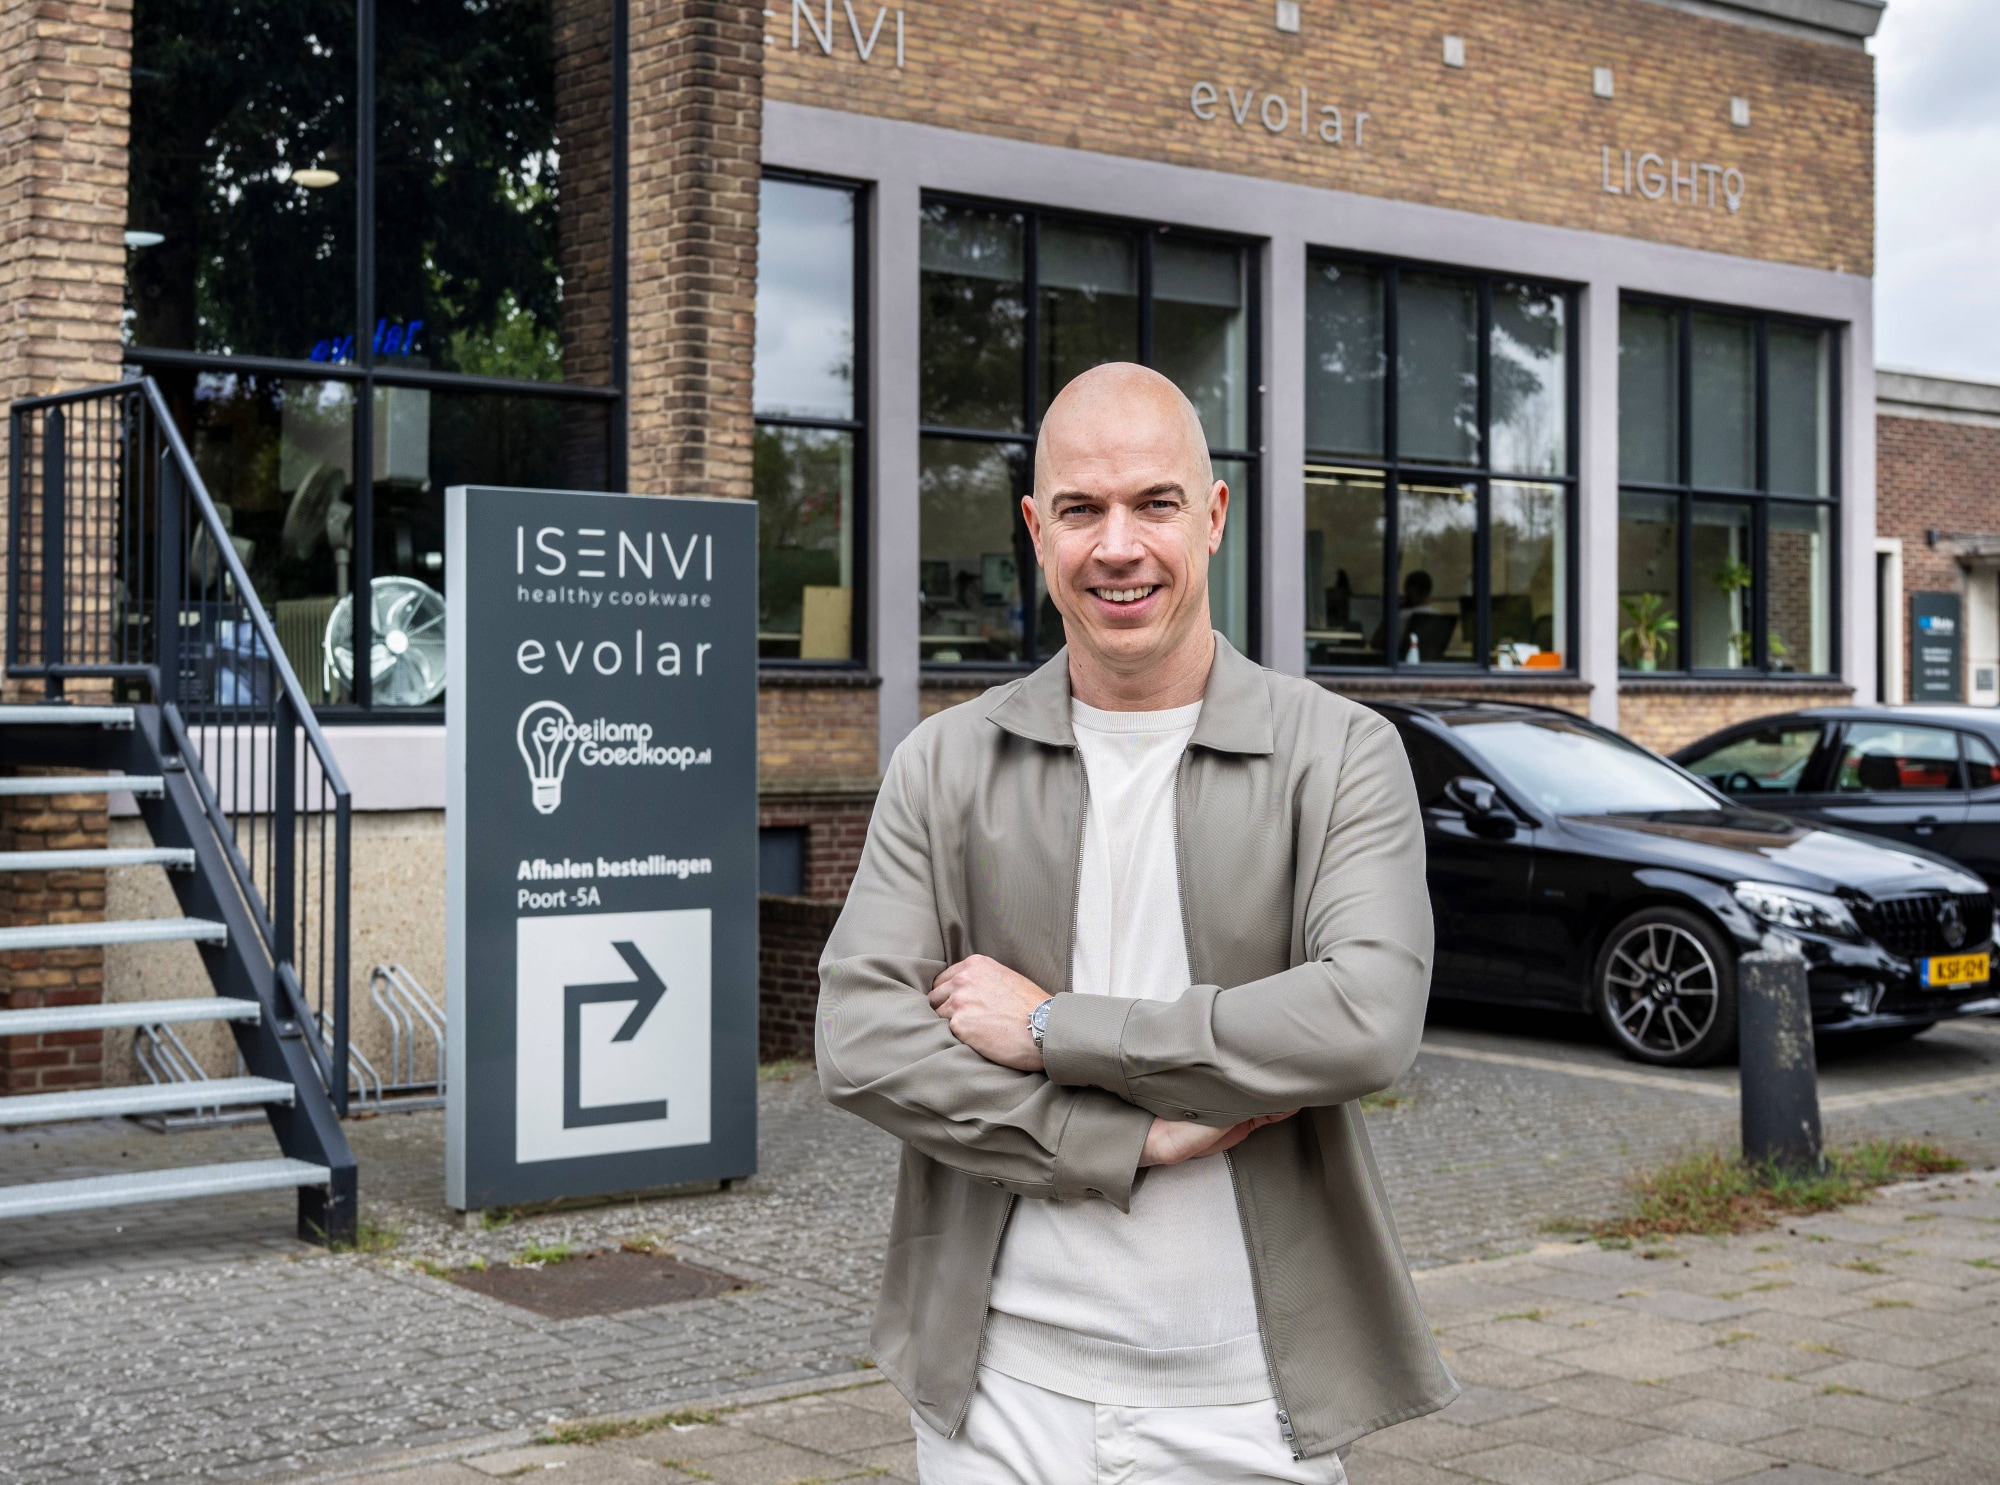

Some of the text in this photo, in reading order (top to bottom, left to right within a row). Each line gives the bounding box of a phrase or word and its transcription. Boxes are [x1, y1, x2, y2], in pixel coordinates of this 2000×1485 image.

[1190, 80, 1371, 147] evolar
[516, 525, 713, 582] ISENVI
[517, 584, 712, 608] healthy cookware
[516, 628, 712, 677] evolar
[536, 716, 653, 745] Gloeilamp
[516, 854, 713, 881] Afhalen bestellingen
[517, 885, 601, 909] Poort -5A
